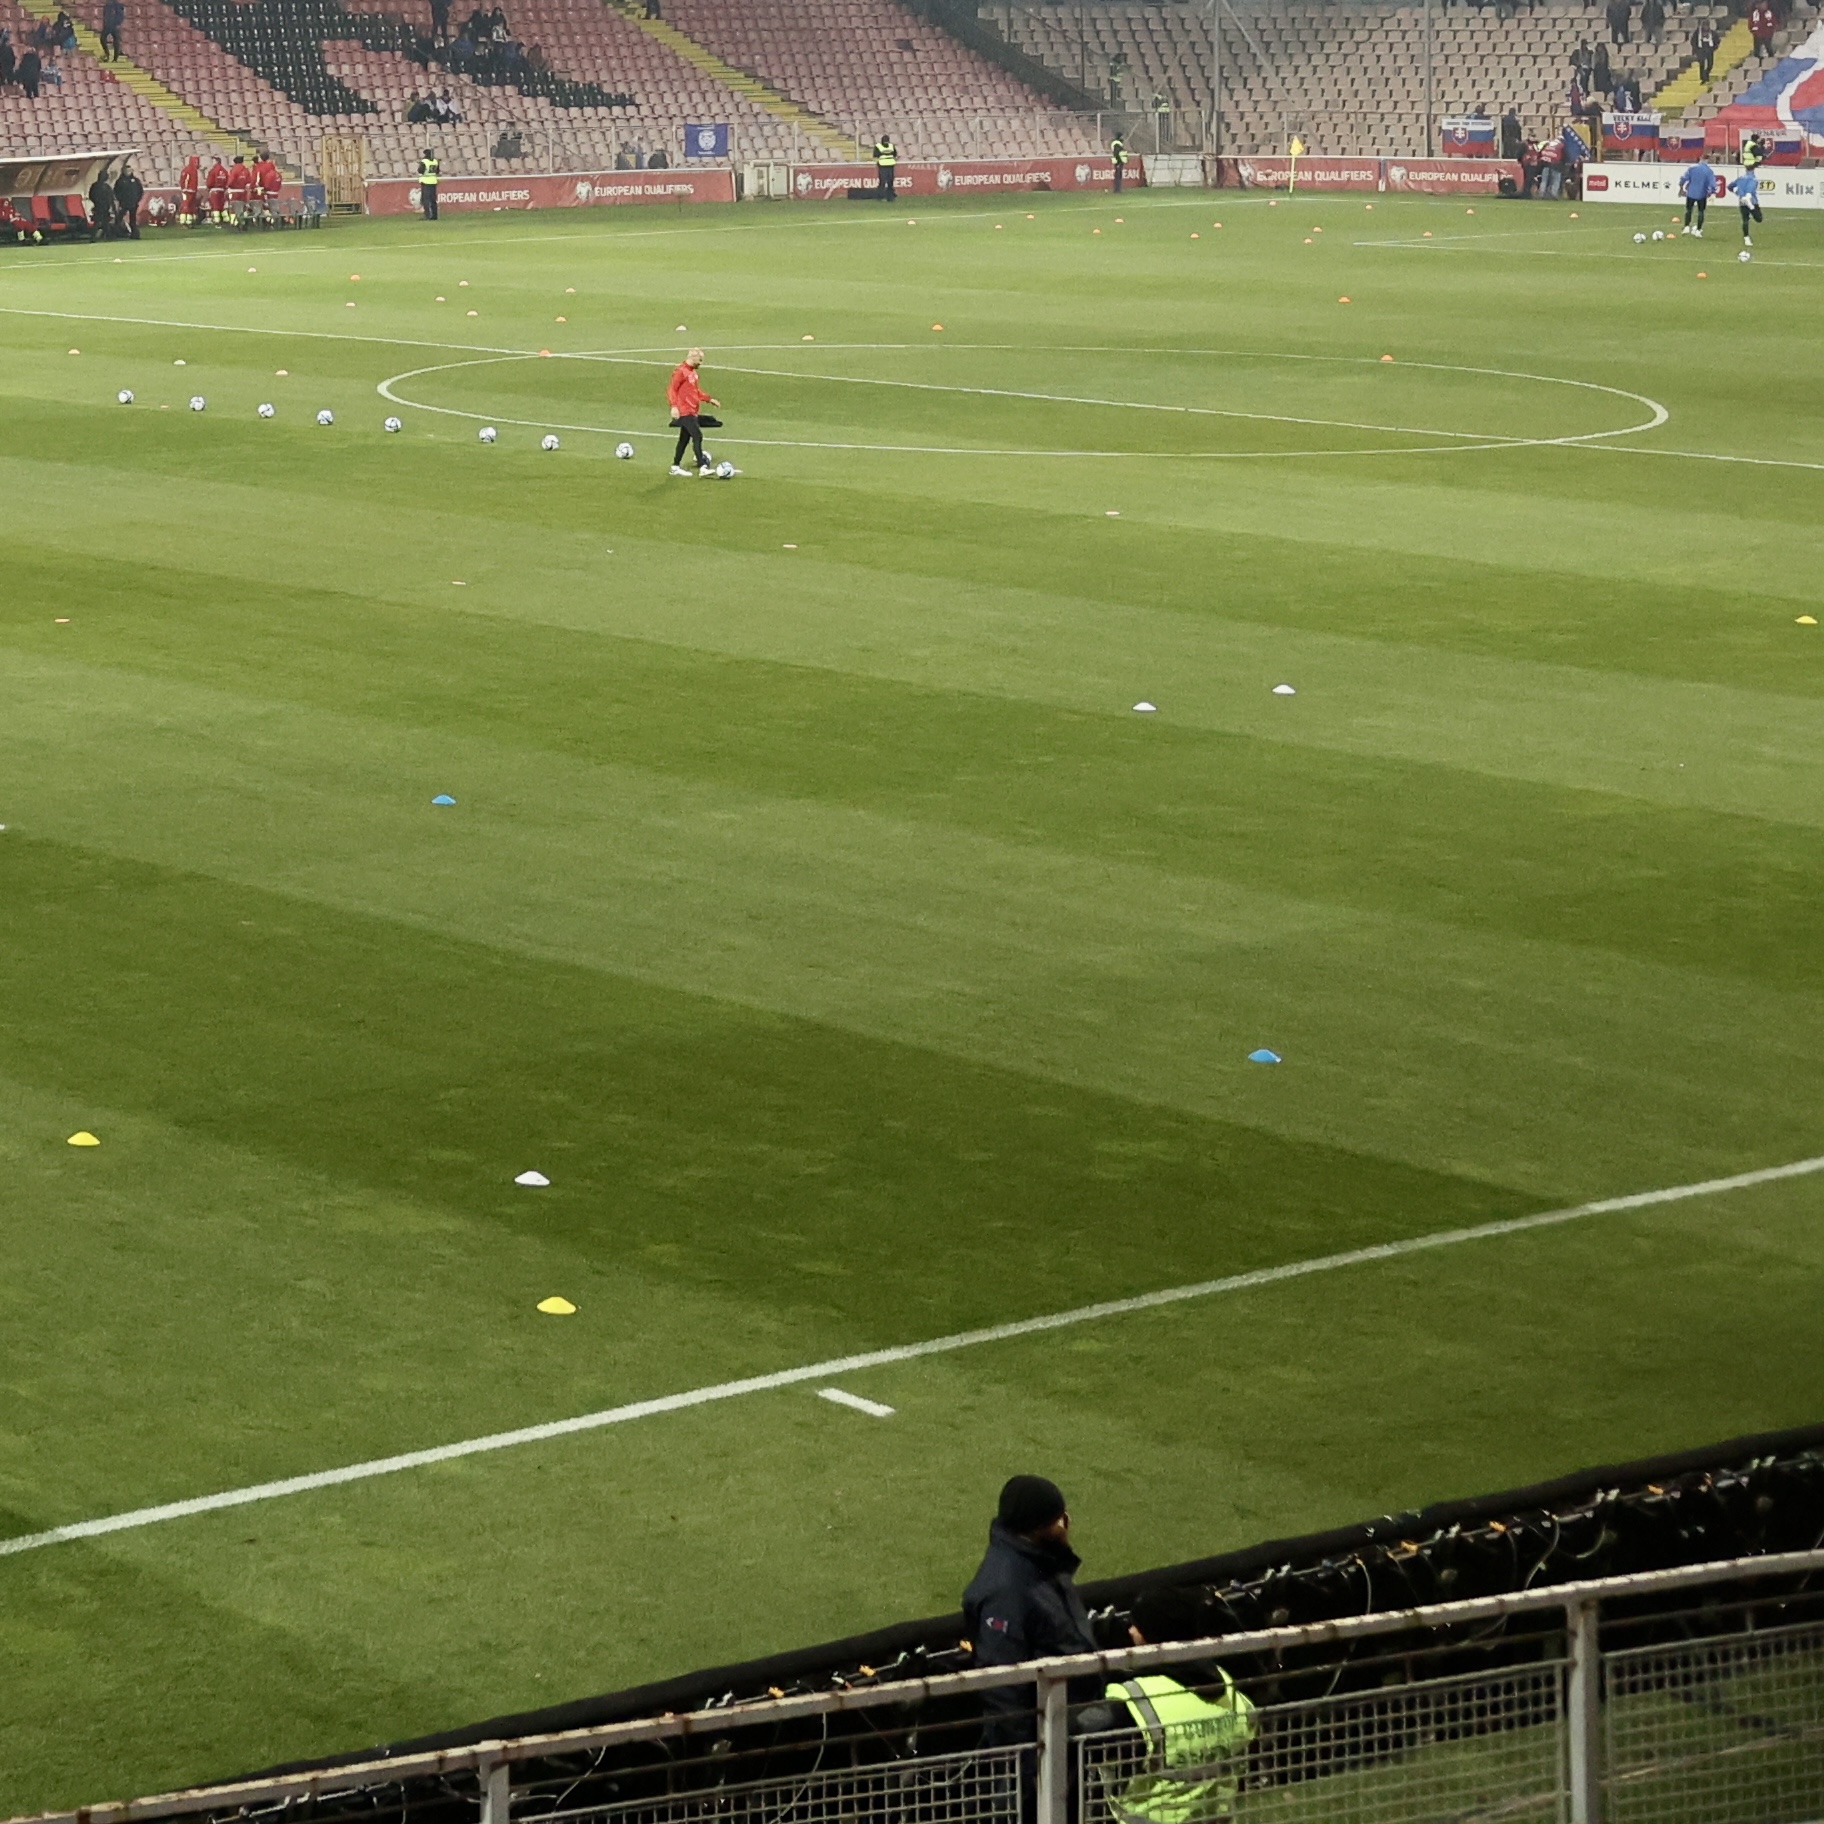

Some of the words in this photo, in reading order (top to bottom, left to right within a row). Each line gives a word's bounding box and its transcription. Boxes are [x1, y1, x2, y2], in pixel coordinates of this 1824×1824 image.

[954, 174, 1001, 186] EUROPEAN
[1002, 171, 1052, 184] QUALIFIERS
[1093, 168, 1141, 180] EUROEAN
[1257, 171, 1312, 182] EUROPEAN
[1315, 170, 1373, 181] QUALIFIERS
[1409, 171, 1458, 182] EUROPEAN
[814, 177, 862, 189] EUROPEAN
[1614, 179, 1659, 190] KELME
[1785, 181, 1814, 195] klix
[436, 191, 477, 204] UROPEAN
[478, 189, 530, 202] QUALIFIERS
[594, 184, 642, 197] EUROPEAN
[644, 183, 694, 195] QUALIFIERS
